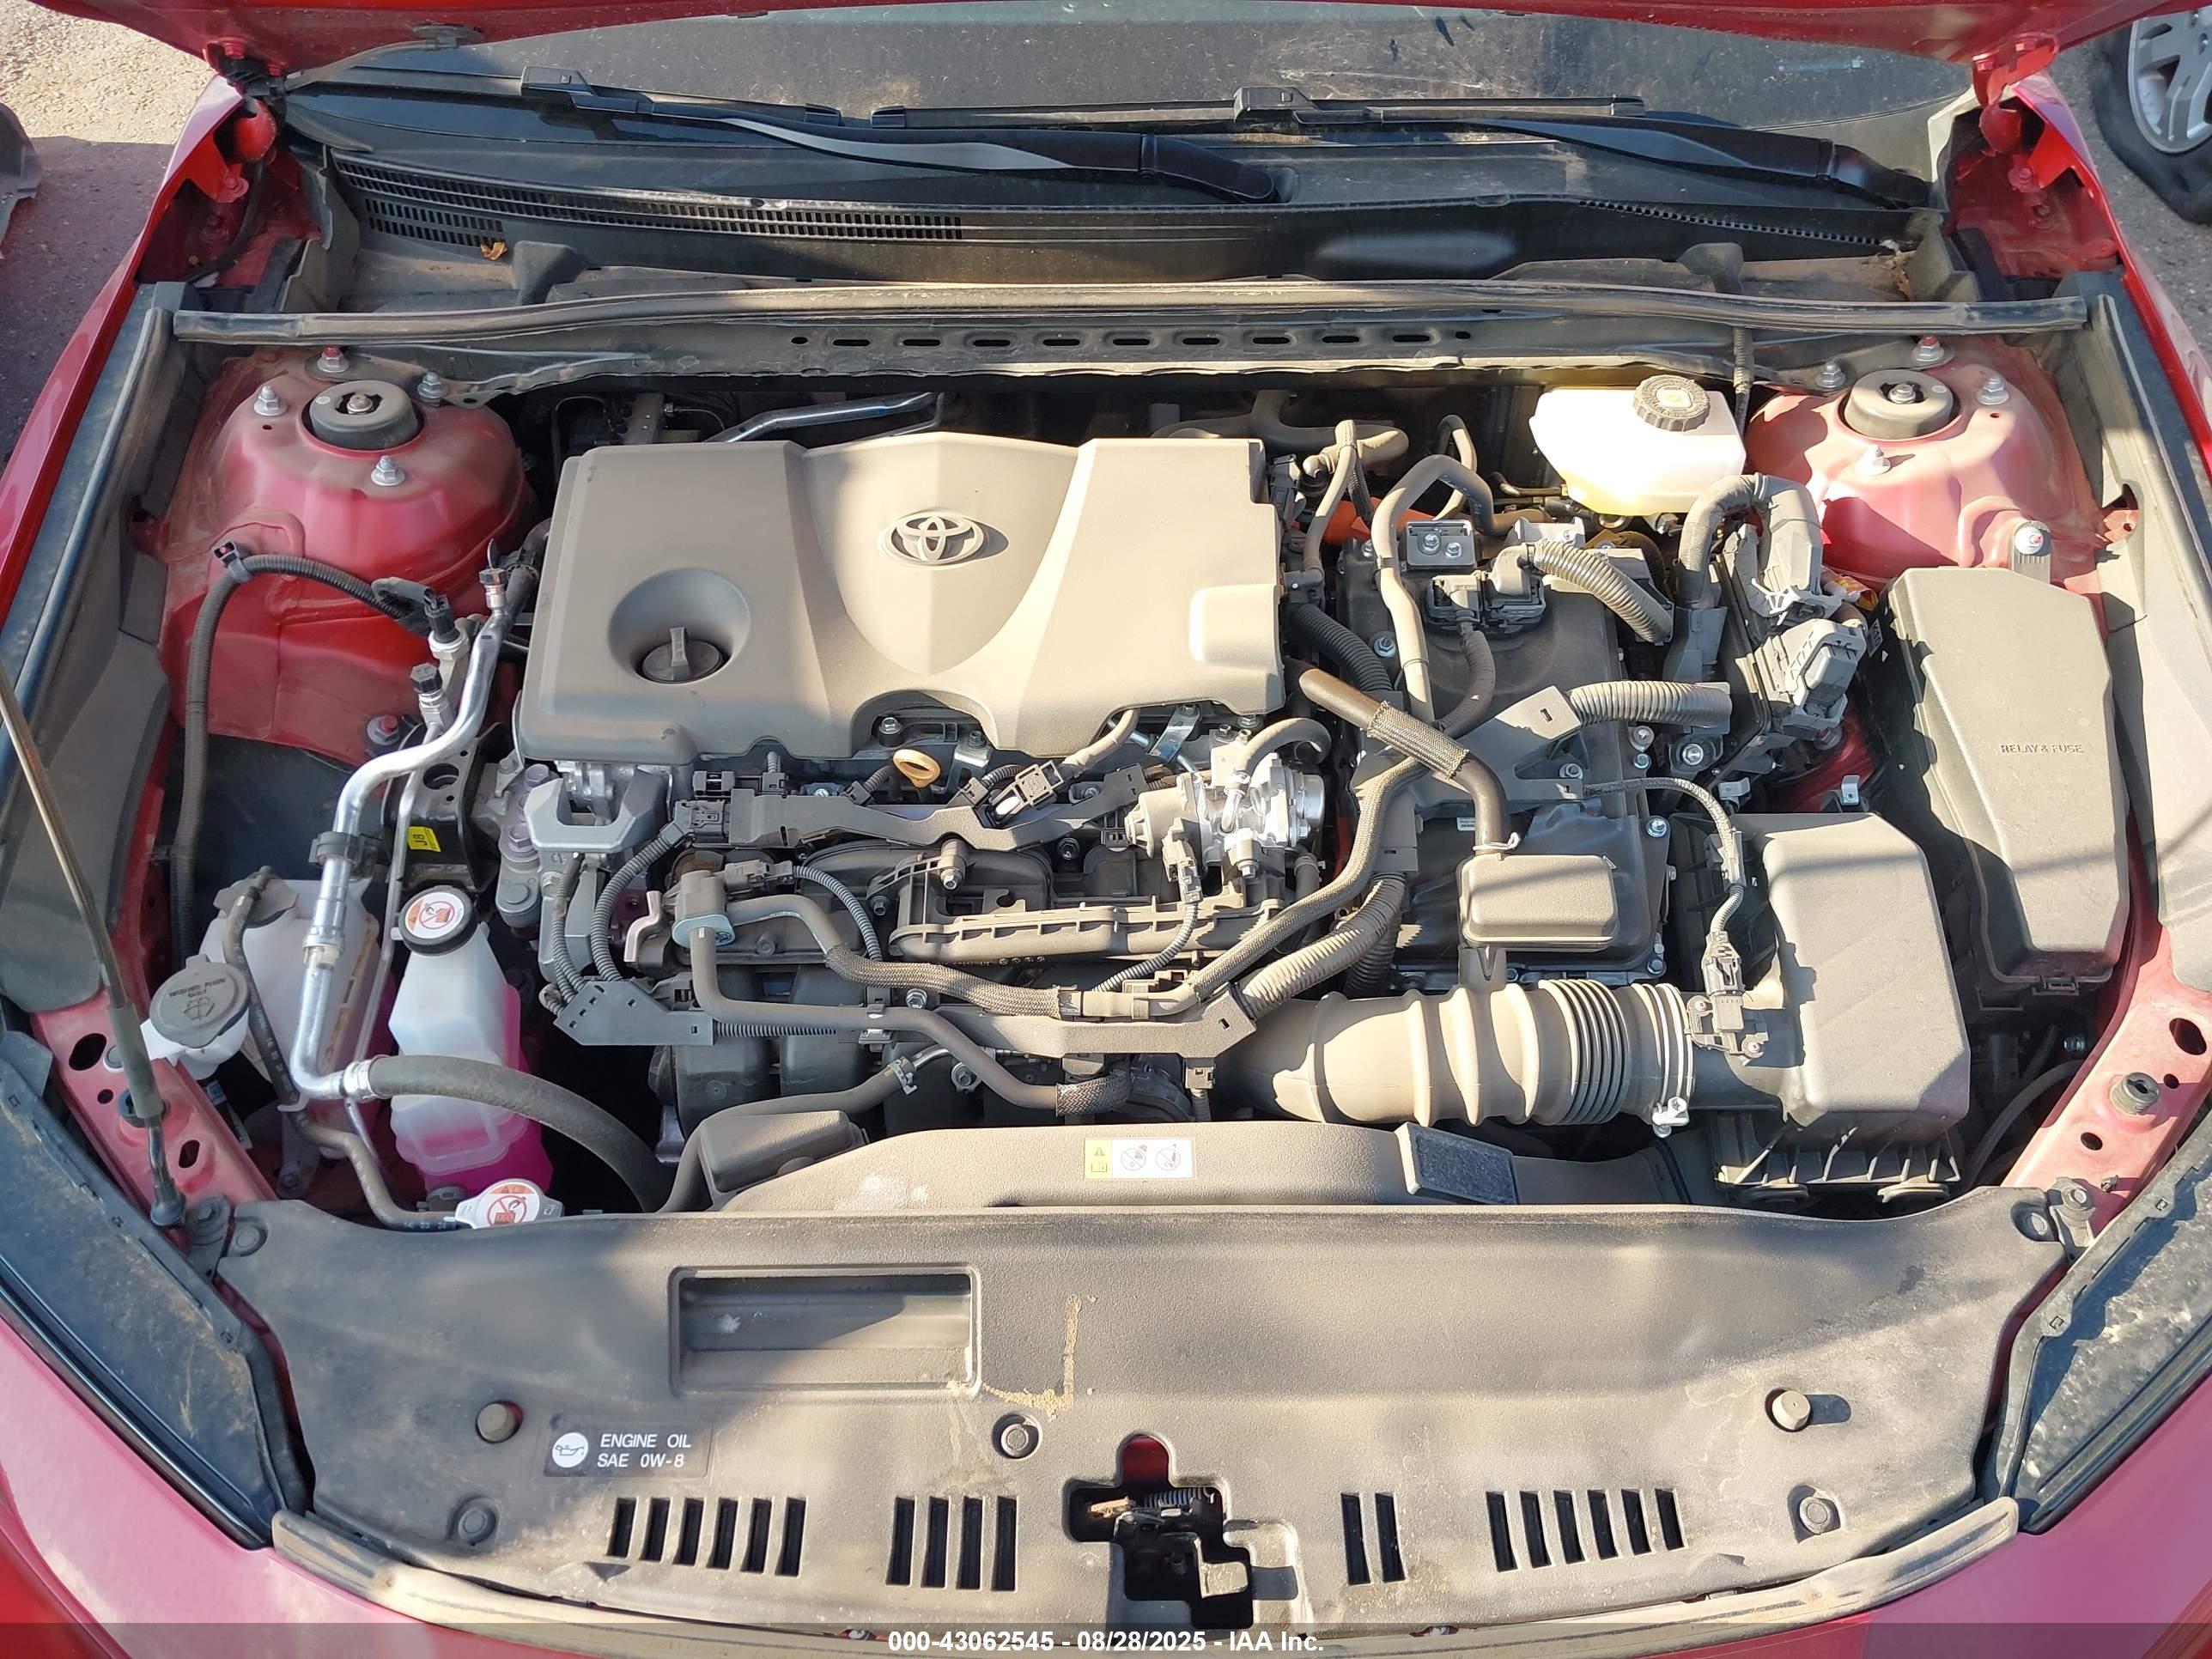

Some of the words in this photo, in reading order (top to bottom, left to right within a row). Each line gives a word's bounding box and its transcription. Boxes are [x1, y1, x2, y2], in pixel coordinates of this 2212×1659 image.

[2000, 744, 2038, 753] RELAY
[2040, 744, 2049, 753] &
[2051, 744, 2084, 753] FUSE
[599, 1433, 659, 1449] ENGINE
[666, 1433, 692, 1449] OIL
[597, 1453, 630, 1468] SAE
[640, 1453, 685, 1468] 0W-8
